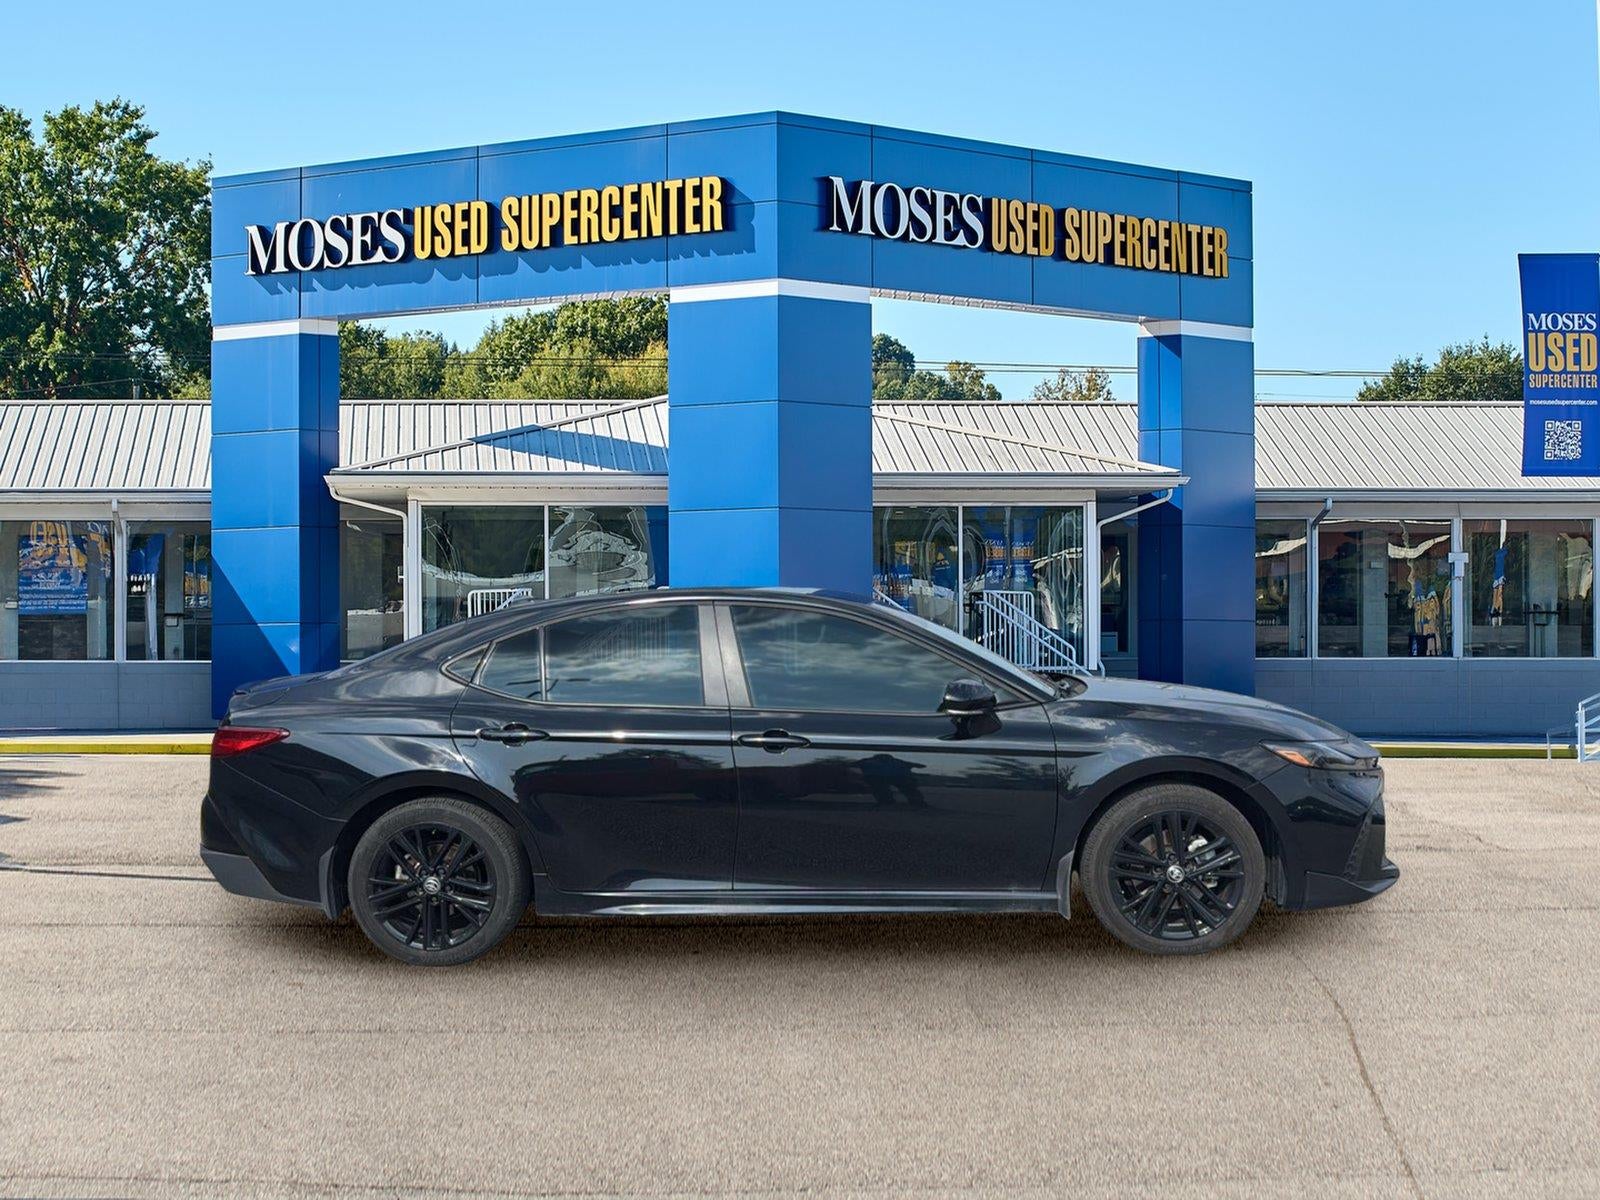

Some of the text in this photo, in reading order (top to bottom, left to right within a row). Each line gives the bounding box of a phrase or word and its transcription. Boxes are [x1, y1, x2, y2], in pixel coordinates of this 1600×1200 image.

[245, 175, 724, 277] MOSES USED SUPERCENTER
[829, 176, 1229, 279] MOSES USED SUPERCENTER
[1528, 313, 1597, 331] MOSES
[1528, 332, 1598, 372] USED
[1529, 373, 1598, 388] SUPERCENTER
